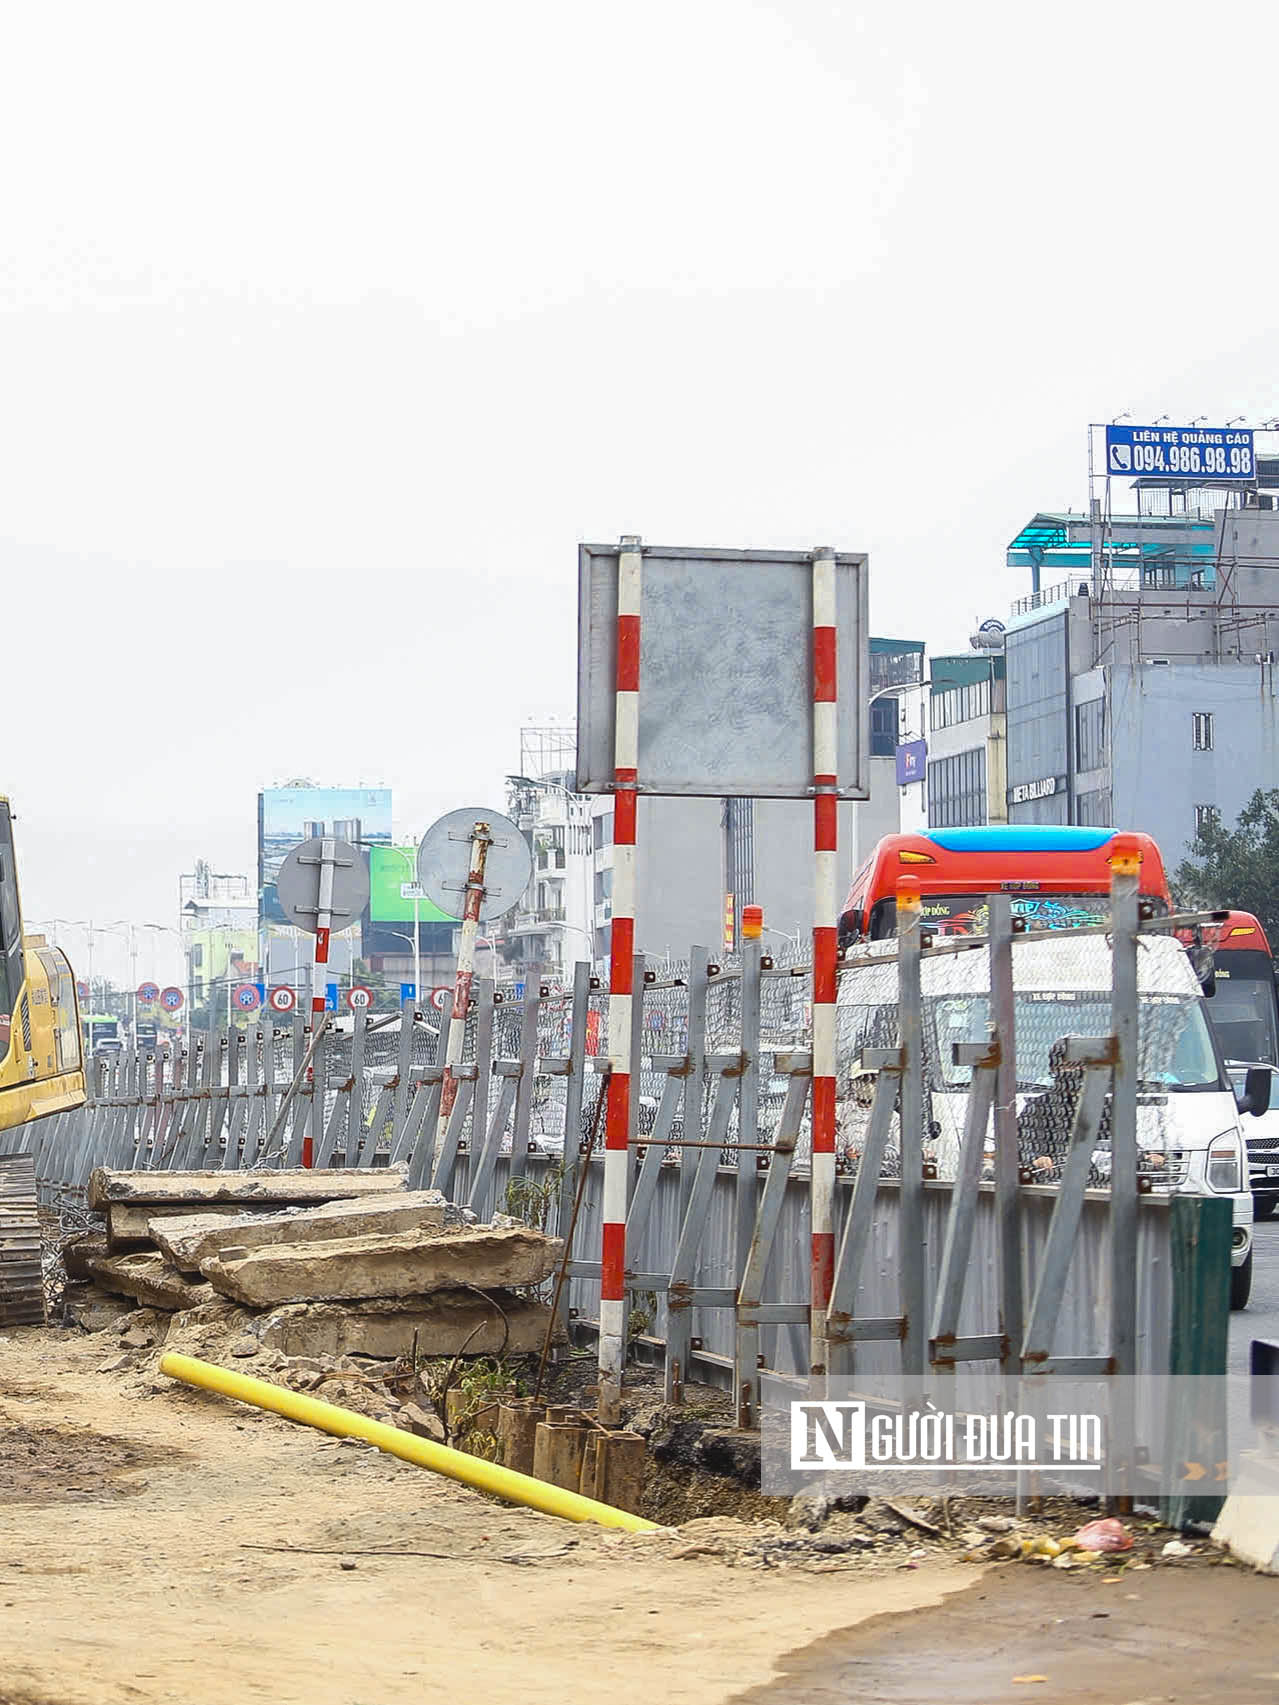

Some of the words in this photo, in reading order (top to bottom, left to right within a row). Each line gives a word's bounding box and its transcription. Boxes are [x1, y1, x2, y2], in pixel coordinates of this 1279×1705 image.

[1133, 431, 1160, 442] LIÊN
[1163, 432, 1179, 446] HỆ
[1181, 431, 1223, 445] QUẢNG
[1225, 433, 1250, 445] CÁO
[1133, 445, 1252, 474] 094.986.98.98
[1010, 903, 1034, 914] VIP
[276, 992, 289, 1005] 60
[354, 993, 366, 1005] 60
